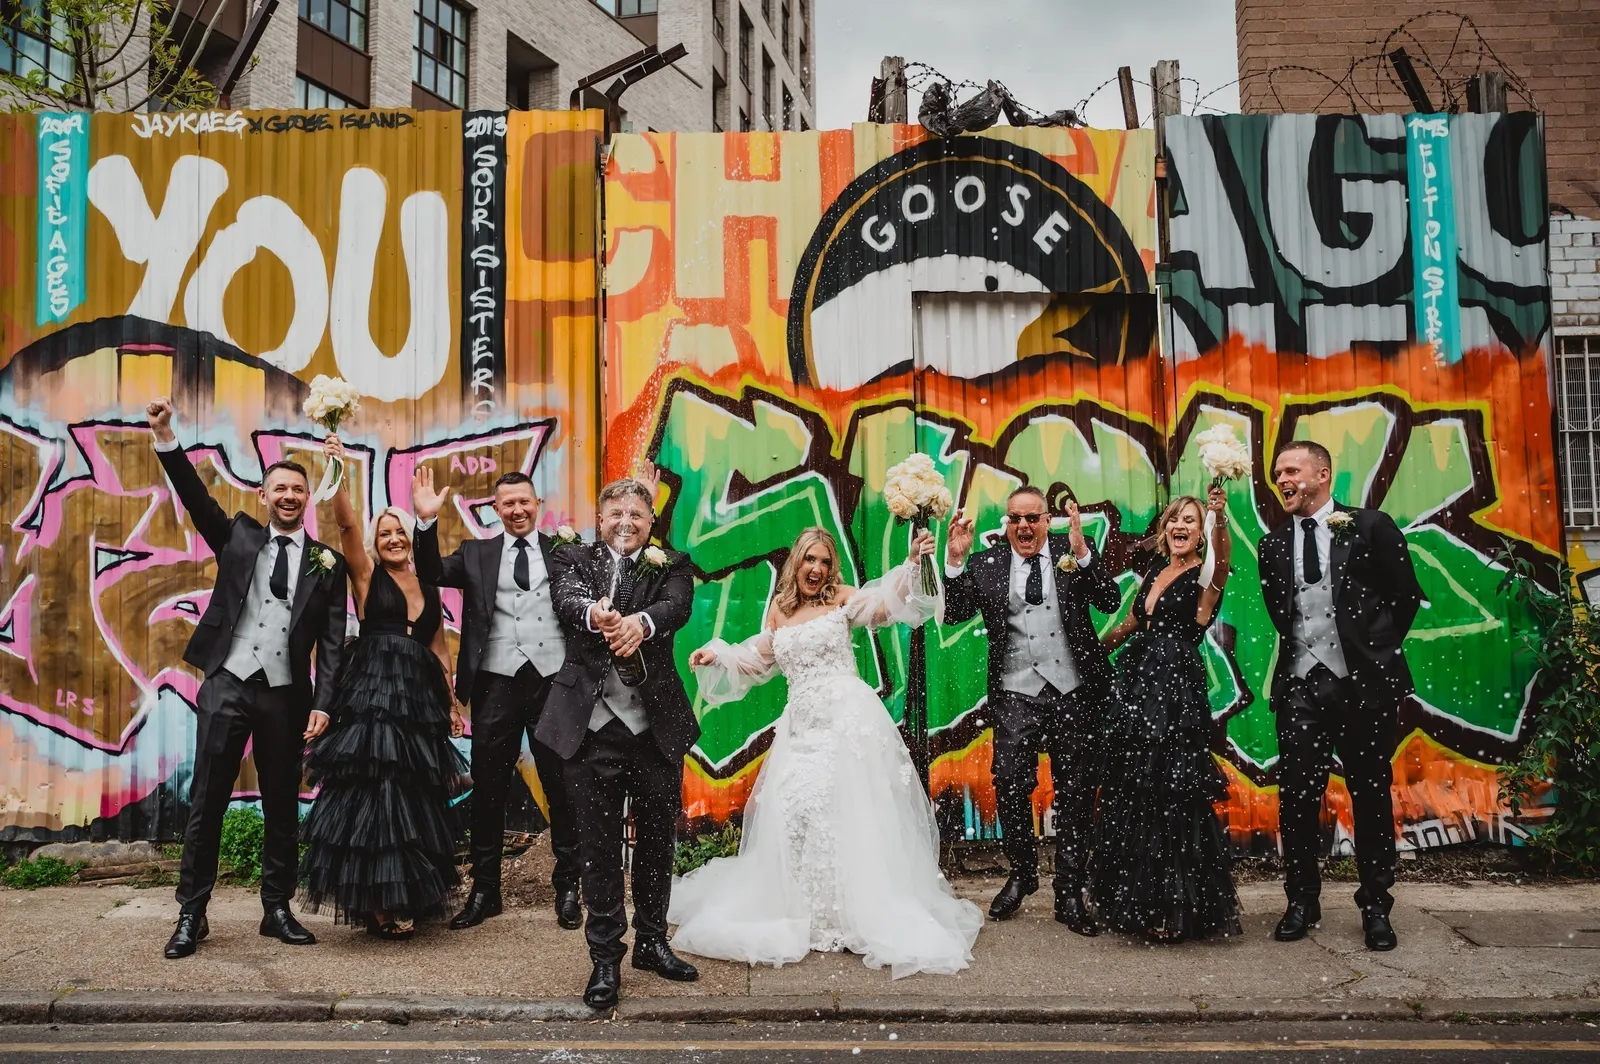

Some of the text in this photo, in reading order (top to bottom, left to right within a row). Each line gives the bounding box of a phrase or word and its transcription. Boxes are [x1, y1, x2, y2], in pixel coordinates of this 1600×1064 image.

[131, 111, 249, 140] JAYKAES
[264, 113, 333, 133] GOOSE
[340, 111, 413, 130] ISLAND
[464, 116, 508, 137] 2013
[471, 145, 498, 231] SOUR
[861, 175, 1071, 255] GOOSE
[1419, 143, 1442, 261] FULTON
[46, 230, 69, 317] AGED
[87, 154, 451, 402] YOU
[450, 455, 497, 476] ADD
